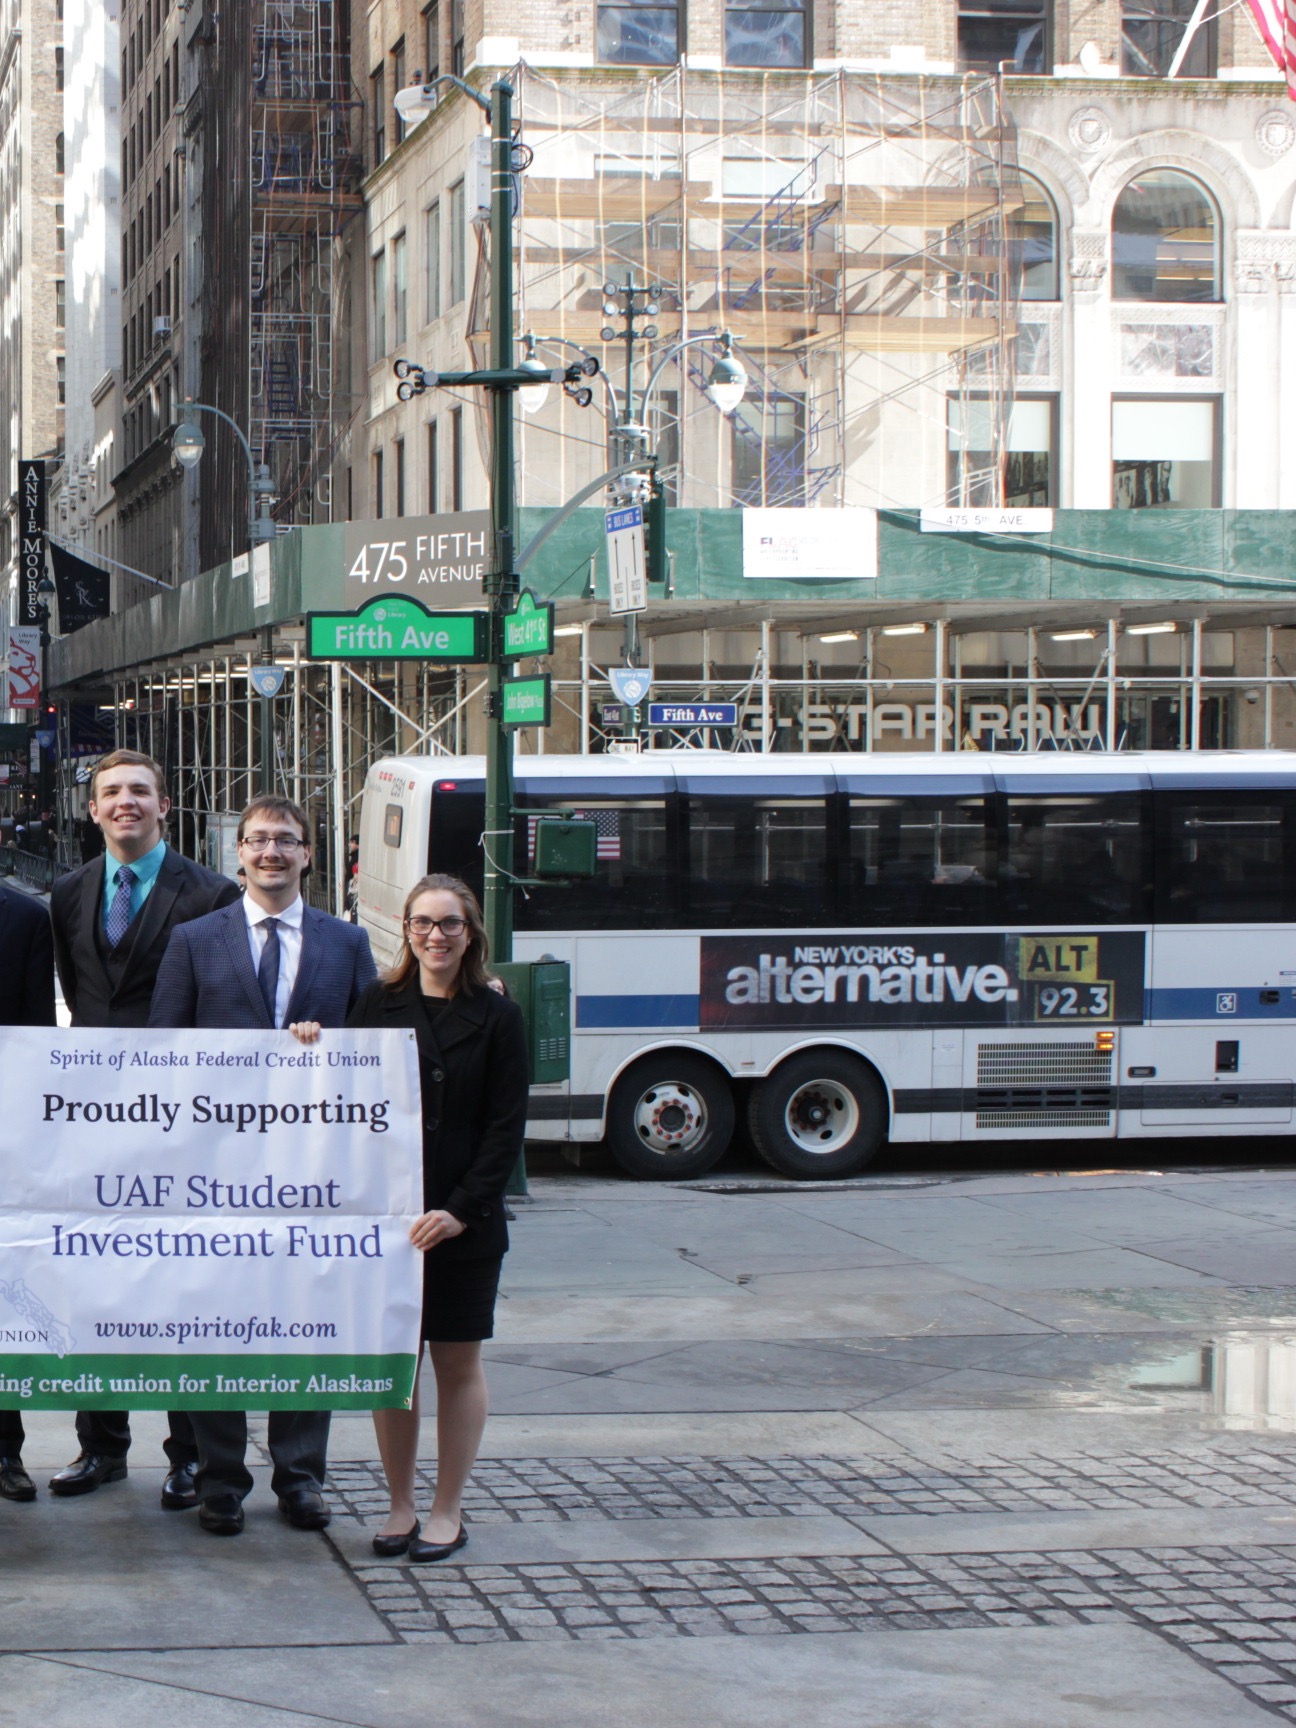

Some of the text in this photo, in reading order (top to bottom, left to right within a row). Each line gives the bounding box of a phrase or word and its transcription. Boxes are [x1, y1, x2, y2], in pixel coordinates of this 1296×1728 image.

[945, 515, 968, 525] 475
[23, 466, 42, 618] ANNIE MOORE'S
[349, 531, 485, 583] 475 FIFTH
[417, 563, 483, 585] AVENUE
[18, 632, 37, 640] Library
[335, 624, 450, 649] Fifth Ave
[507, 622, 524, 646] West
[616, 671, 636, 679] Library
[662, 708, 723, 721] Fifth Ave
[734, 704, 1100, 740] G-STAR RAW
[794, 945, 914, 964] NEW YORK'S
[1028, 944, 1089, 973] ALT
[725, 953, 1019, 1005] alternative.
[1039, 986, 1108, 1016] 92.3
[49, 1050, 382, 1071] Spirit of Alaska Federal Credit Union
[42, 1094, 390, 1133] Proudly Supporting
[95, 1174, 341, 1208] UAF Student
[52, 1224, 383, 1258] Investment Fund
[95, 1316, 338, 1344] www.spiritofak.com
[39, 1374, 103, 1394] credit
[109, 1375, 172, 1394] union
[178, 1374, 210, 1393] for
[215, 1374, 300, 1393] Interior
[305, 1373, 393, 1393] Alaskans
